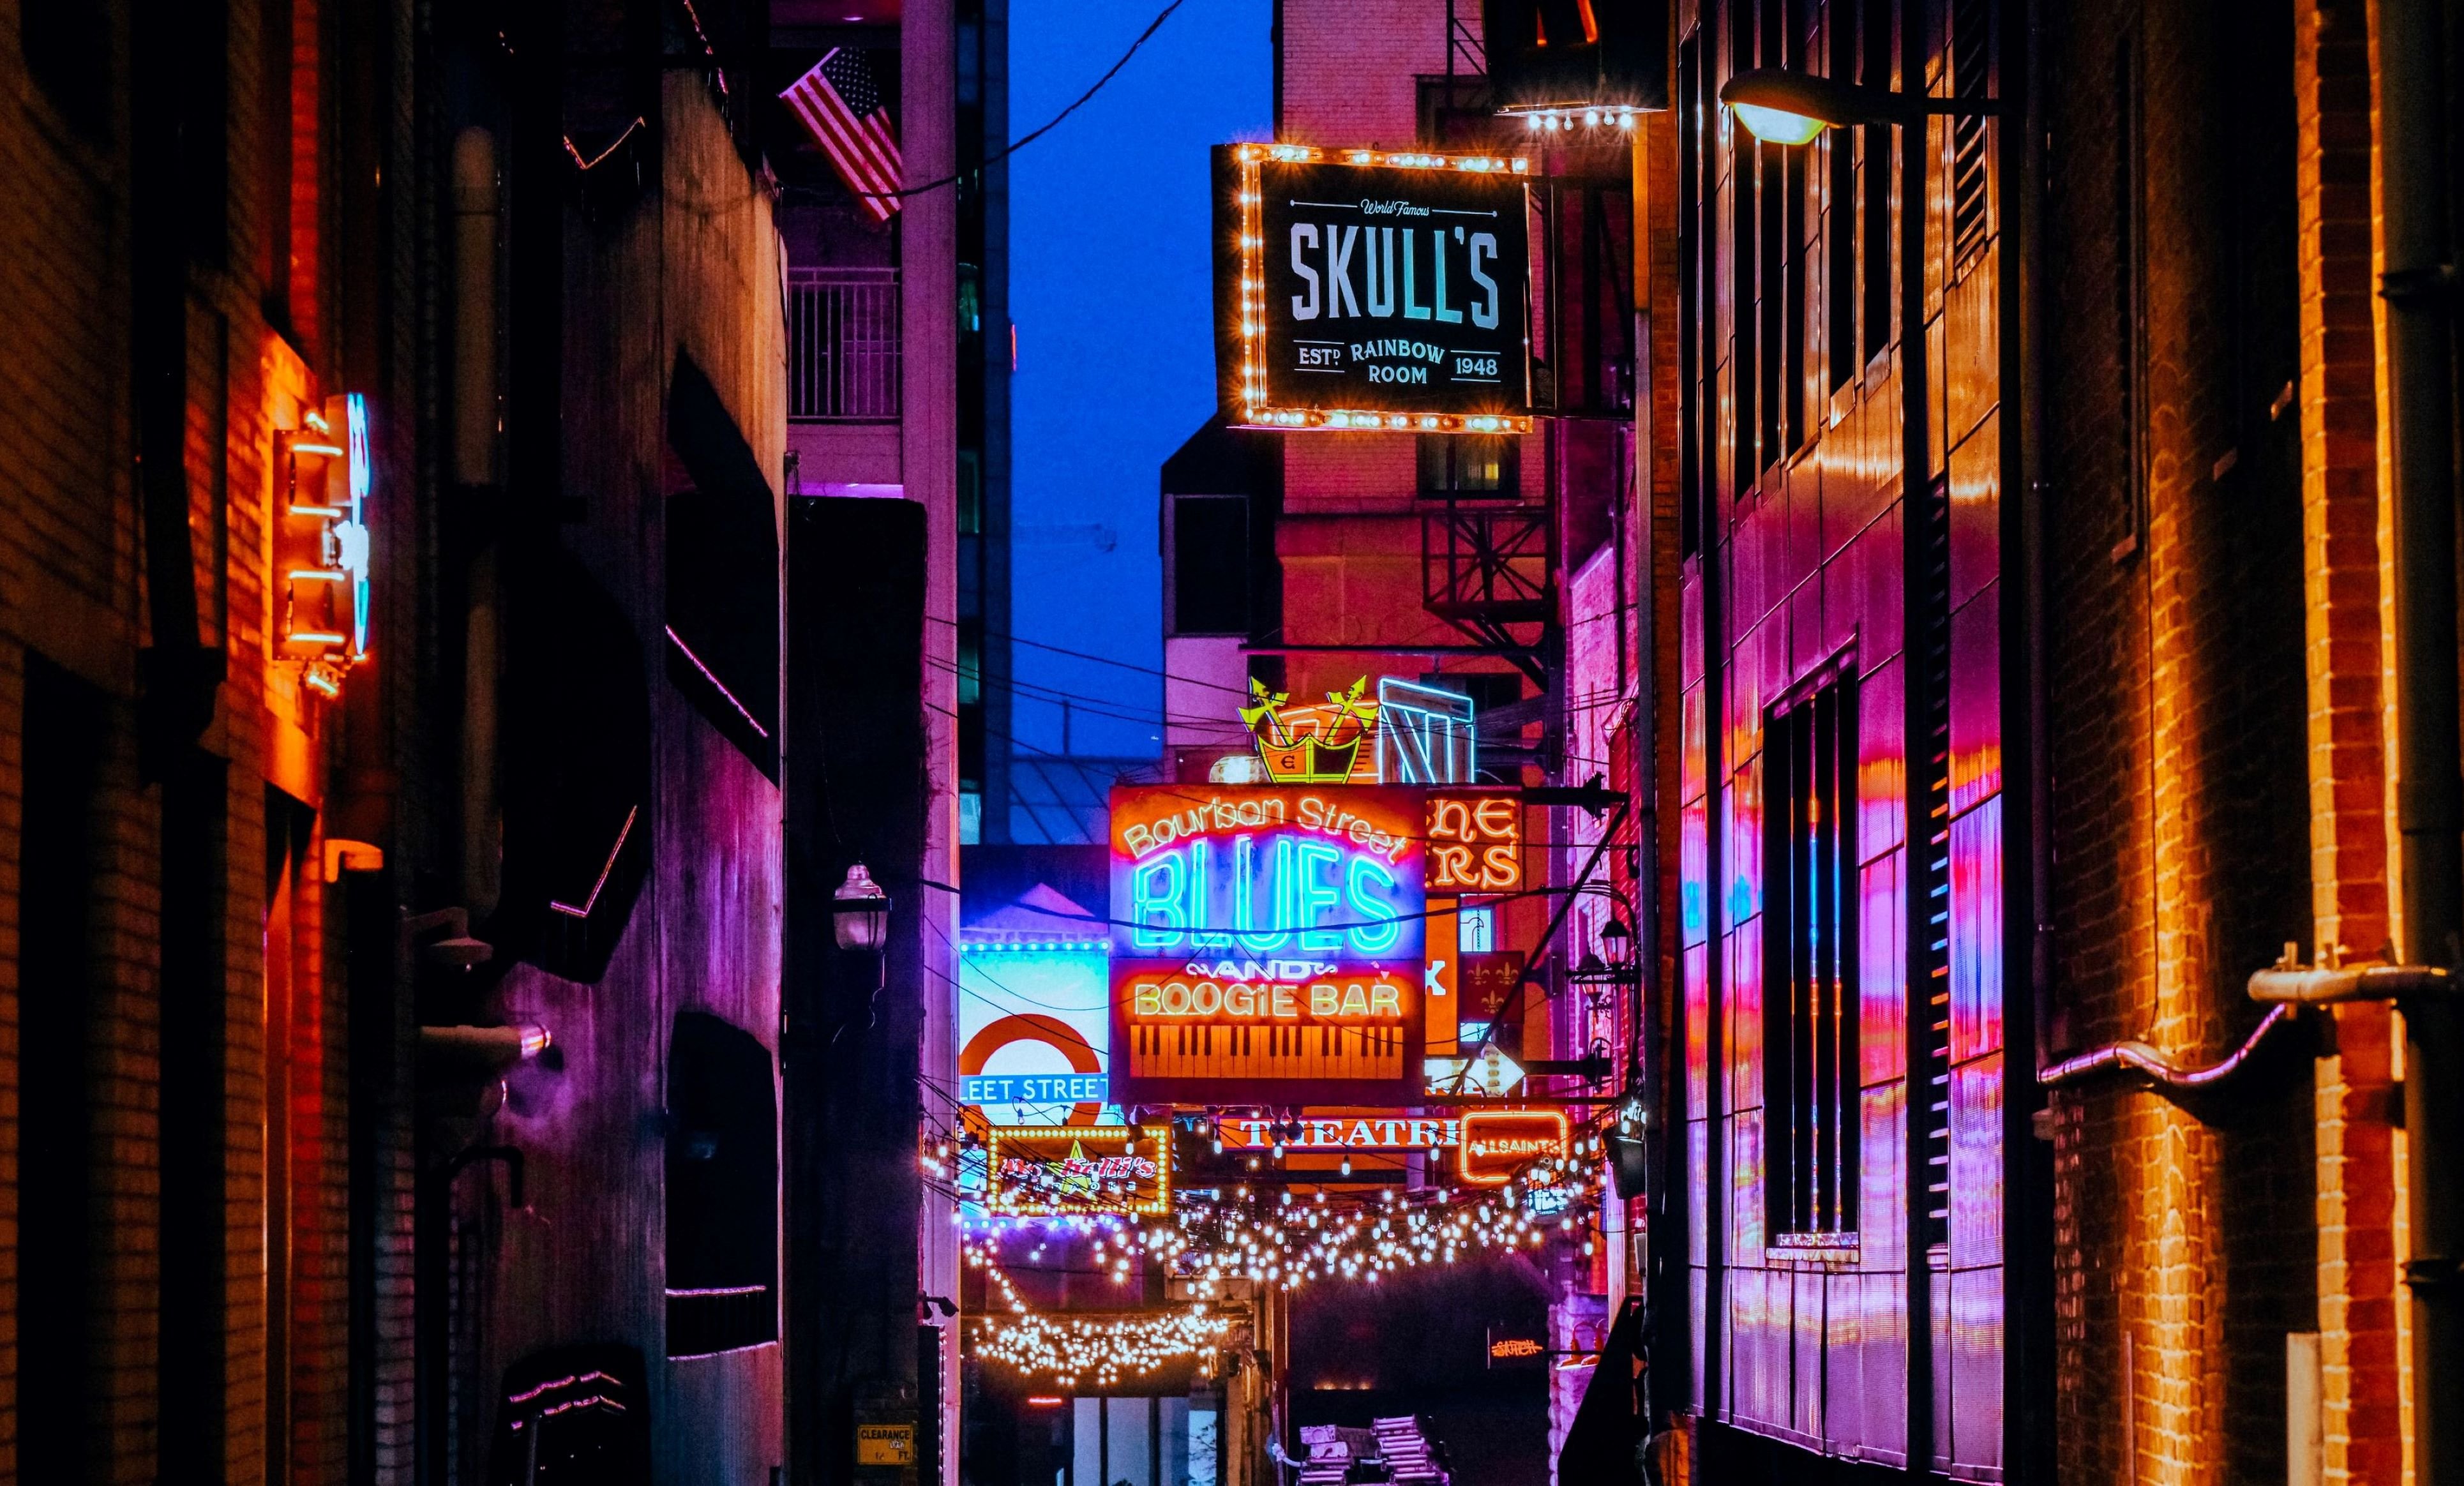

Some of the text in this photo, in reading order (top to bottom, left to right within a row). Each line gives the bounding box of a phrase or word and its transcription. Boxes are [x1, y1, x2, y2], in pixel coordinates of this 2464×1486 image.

[1360, 199, 1430, 217] World Famous
[1289, 222, 1499, 330] SKULL'S
[1350, 339, 1445, 364] RAINBOW
[1368, 364, 1427, 384] ROOM
[1455, 357, 1498, 375] 1948
[1123, 796, 1407, 866] Bourbon Street
[1426, 799, 1519, 843] NE
[1425, 839, 1520, 890] RS
[1134, 834, 1401, 952] BLUES
[1213, 959, 1312, 980] AND
[1311, 984, 1401, 1017] BAR
[960, 1080, 1014, 1100] EET
[860, 1429, 910, 1440] CLEARANCE
